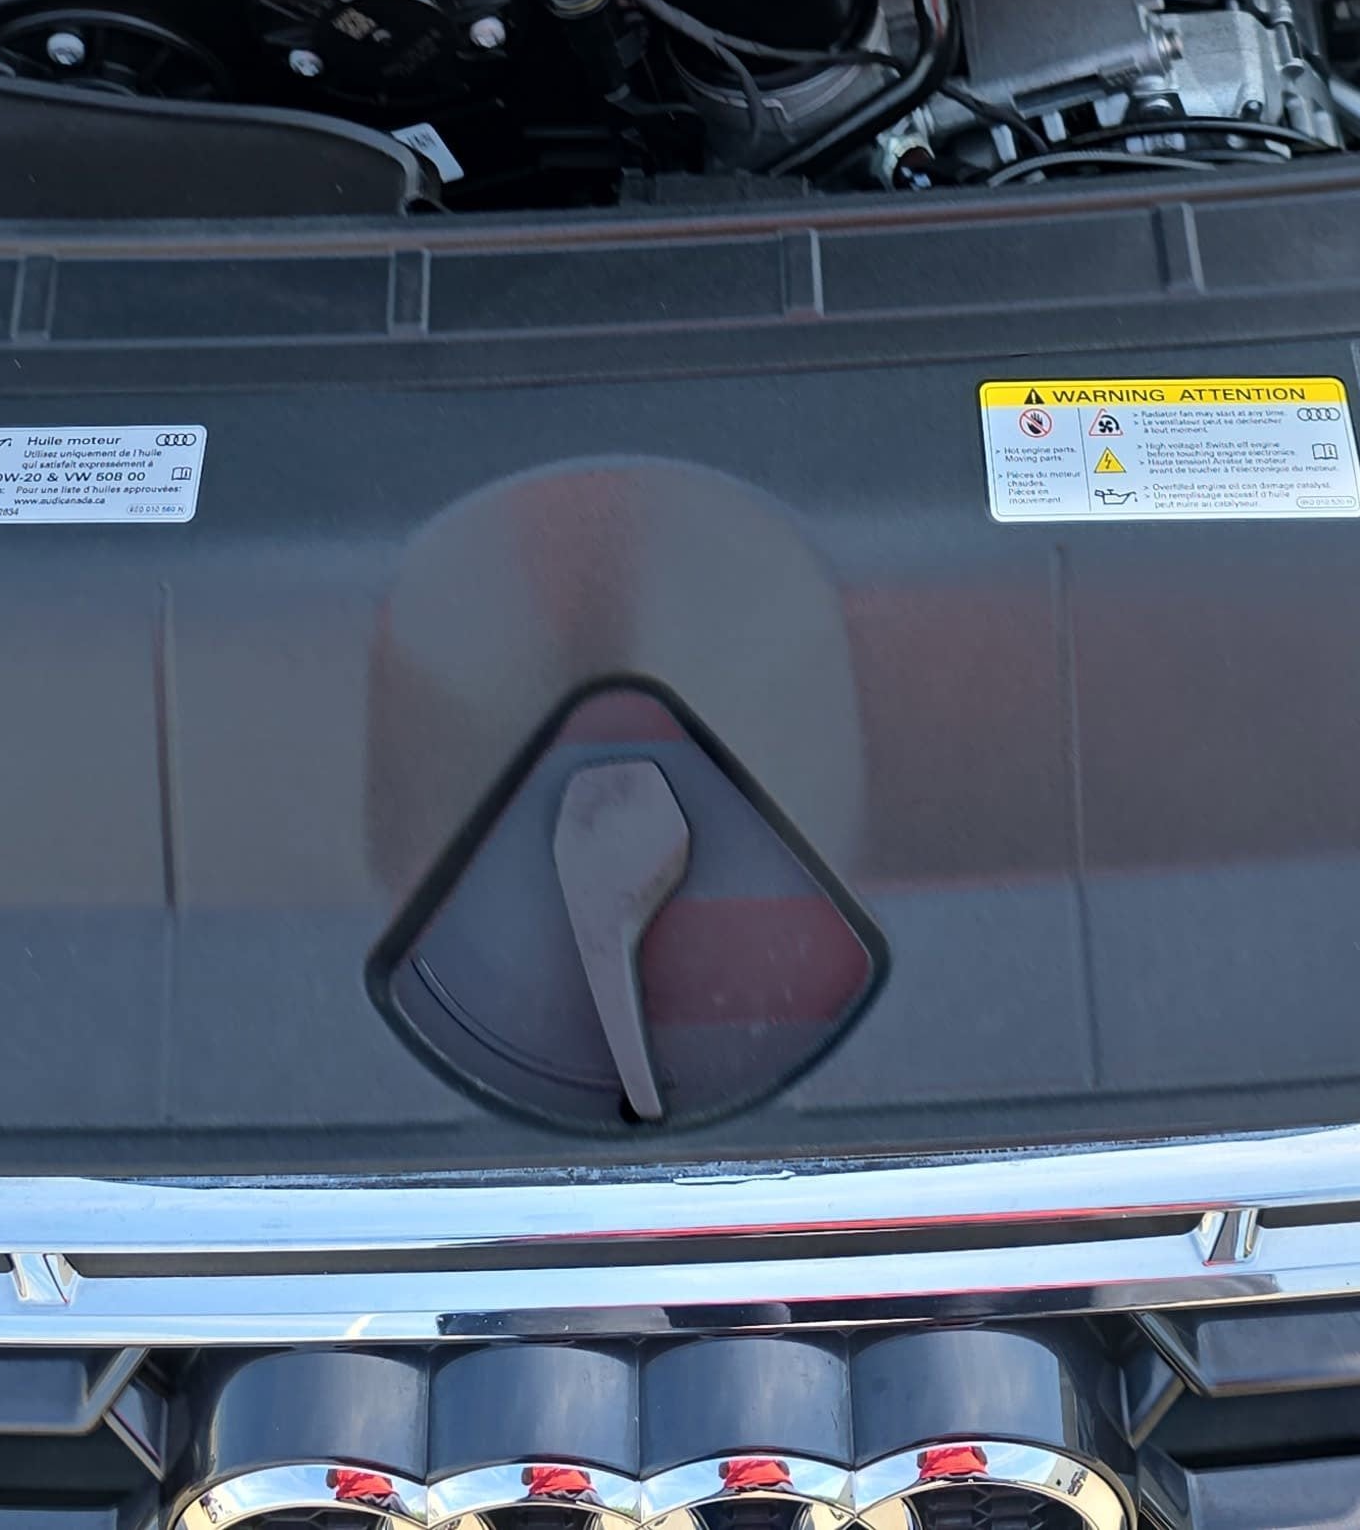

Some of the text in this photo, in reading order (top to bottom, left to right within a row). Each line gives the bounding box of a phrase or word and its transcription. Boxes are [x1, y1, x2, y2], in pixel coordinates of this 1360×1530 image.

[1053, 388, 1306, 402] WARNING ATTENTION
[1179, 410, 1194, 418] fan
[1195, 411, 1214, 419] may
[27, 436, 121, 446] Huile moteur
[1022, 447, 1050, 455] engine
[1145, 443, 1166, 451] High
[24, 450, 57, 458] Utilisez
[60, 450, 116, 460] uniquement
[119, 449, 130, 458] de
[1147, 450, 1174, 458] before
[1005, 455, 1037, 464] Moving
[22, 461, 38, 470] qui
[40, 460, 76, 469] satisfait
[46, 472, 58, 482] &
[64, 472, 92, 482] VW
[96, 472, 123, 482] 508
[127, 472, 145, 482] 00
[16, 486, 39, 494] Pour
[41, 486, 58, 494] une
[61, 485, 82, 494] liste
[1153, 491, 1167, 499] Un
[14, 497, 106, 505] www.audicanada.ca
